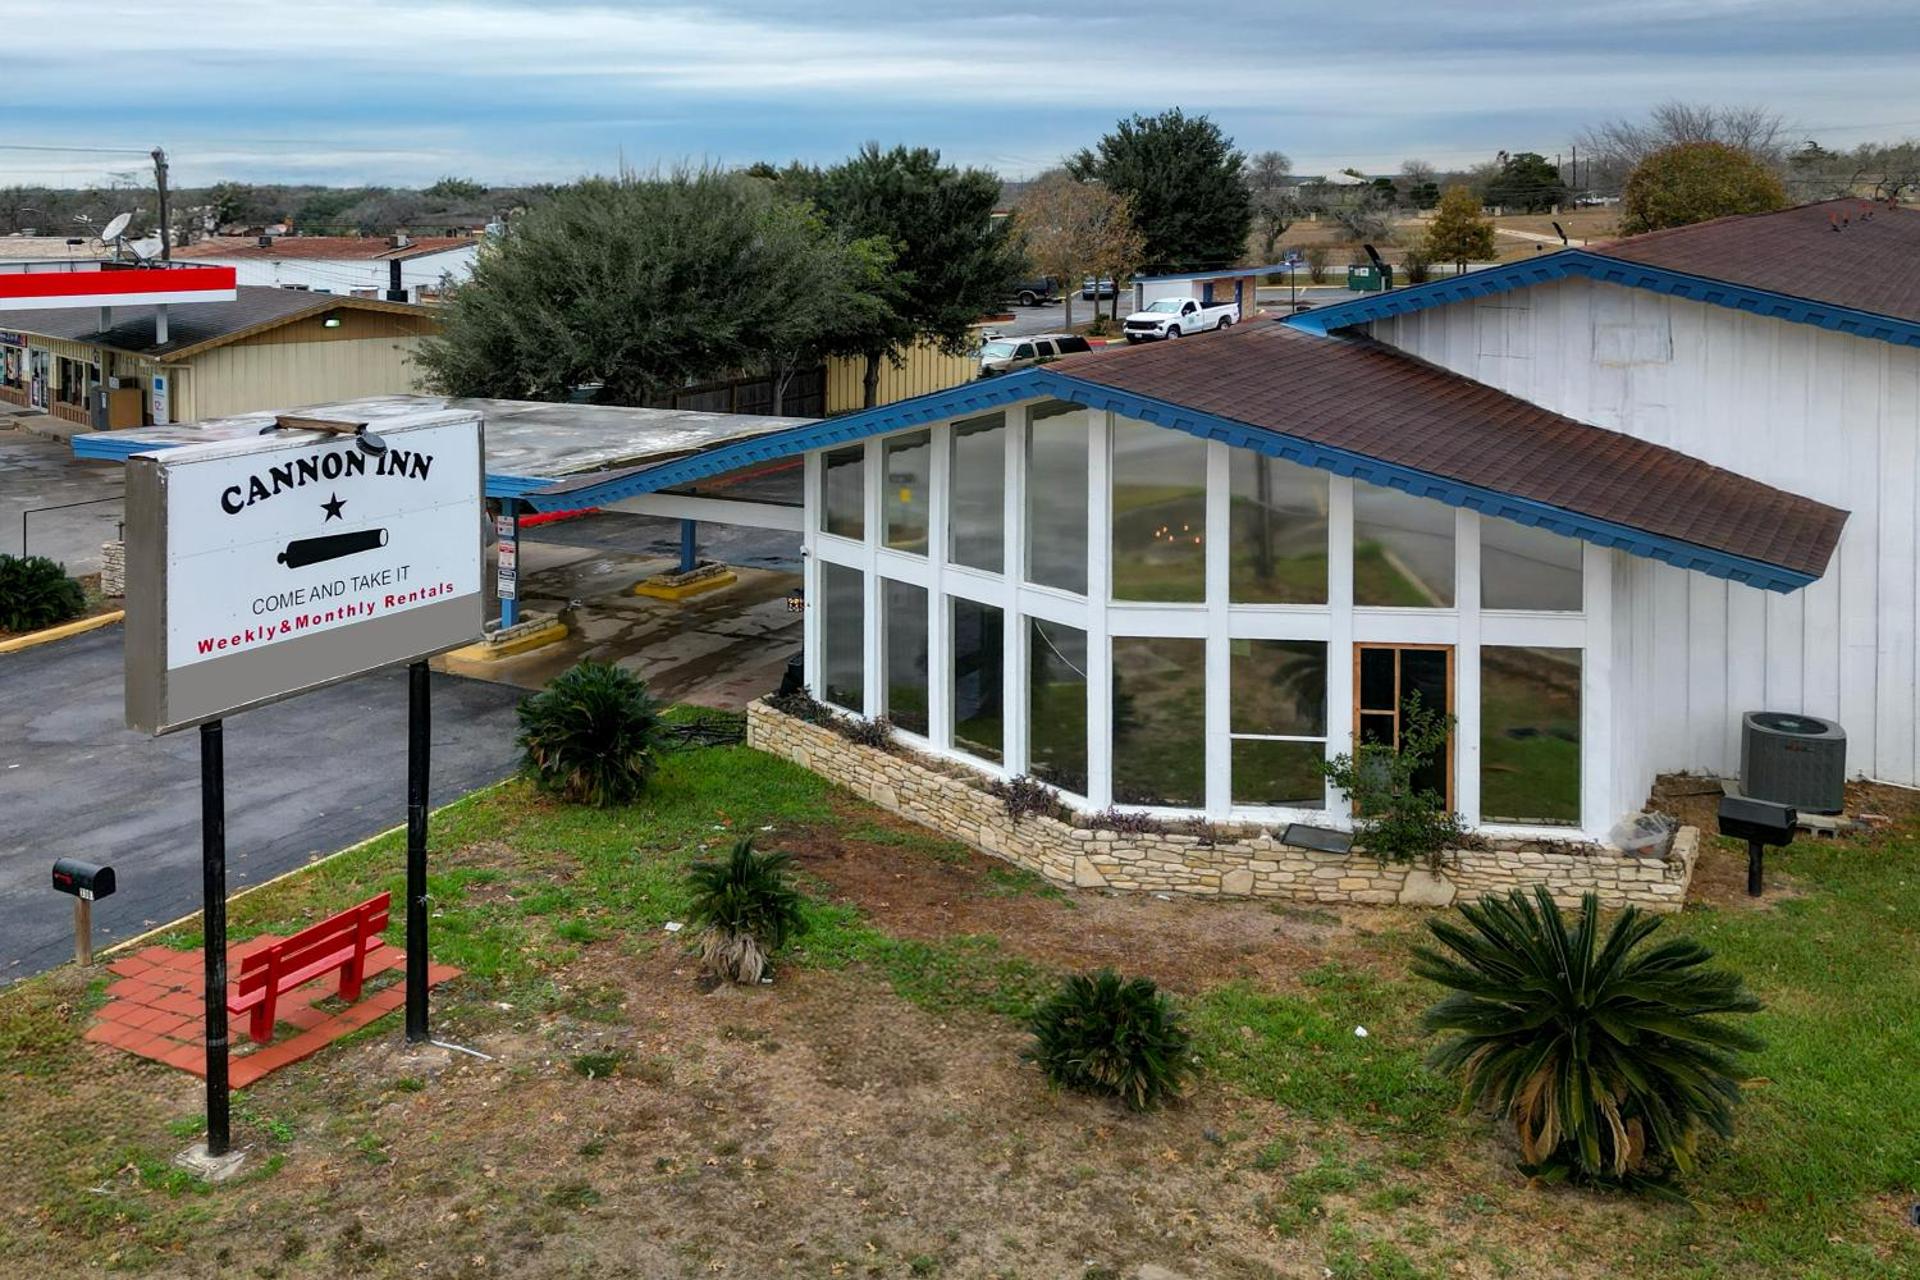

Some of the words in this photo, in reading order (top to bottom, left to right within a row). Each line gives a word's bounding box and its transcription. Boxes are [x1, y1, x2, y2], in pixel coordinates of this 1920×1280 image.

[221, 450, 366, 515] CANNON
[376, 449, 433, 481] INN
[252, 588, 306, 616] COME
[309, 580, 345, 603] AND
[350, 569, 391, 593] TAKE
[396, 565, 411, 582] IT
[384, 582, 455, 609] Rentals
